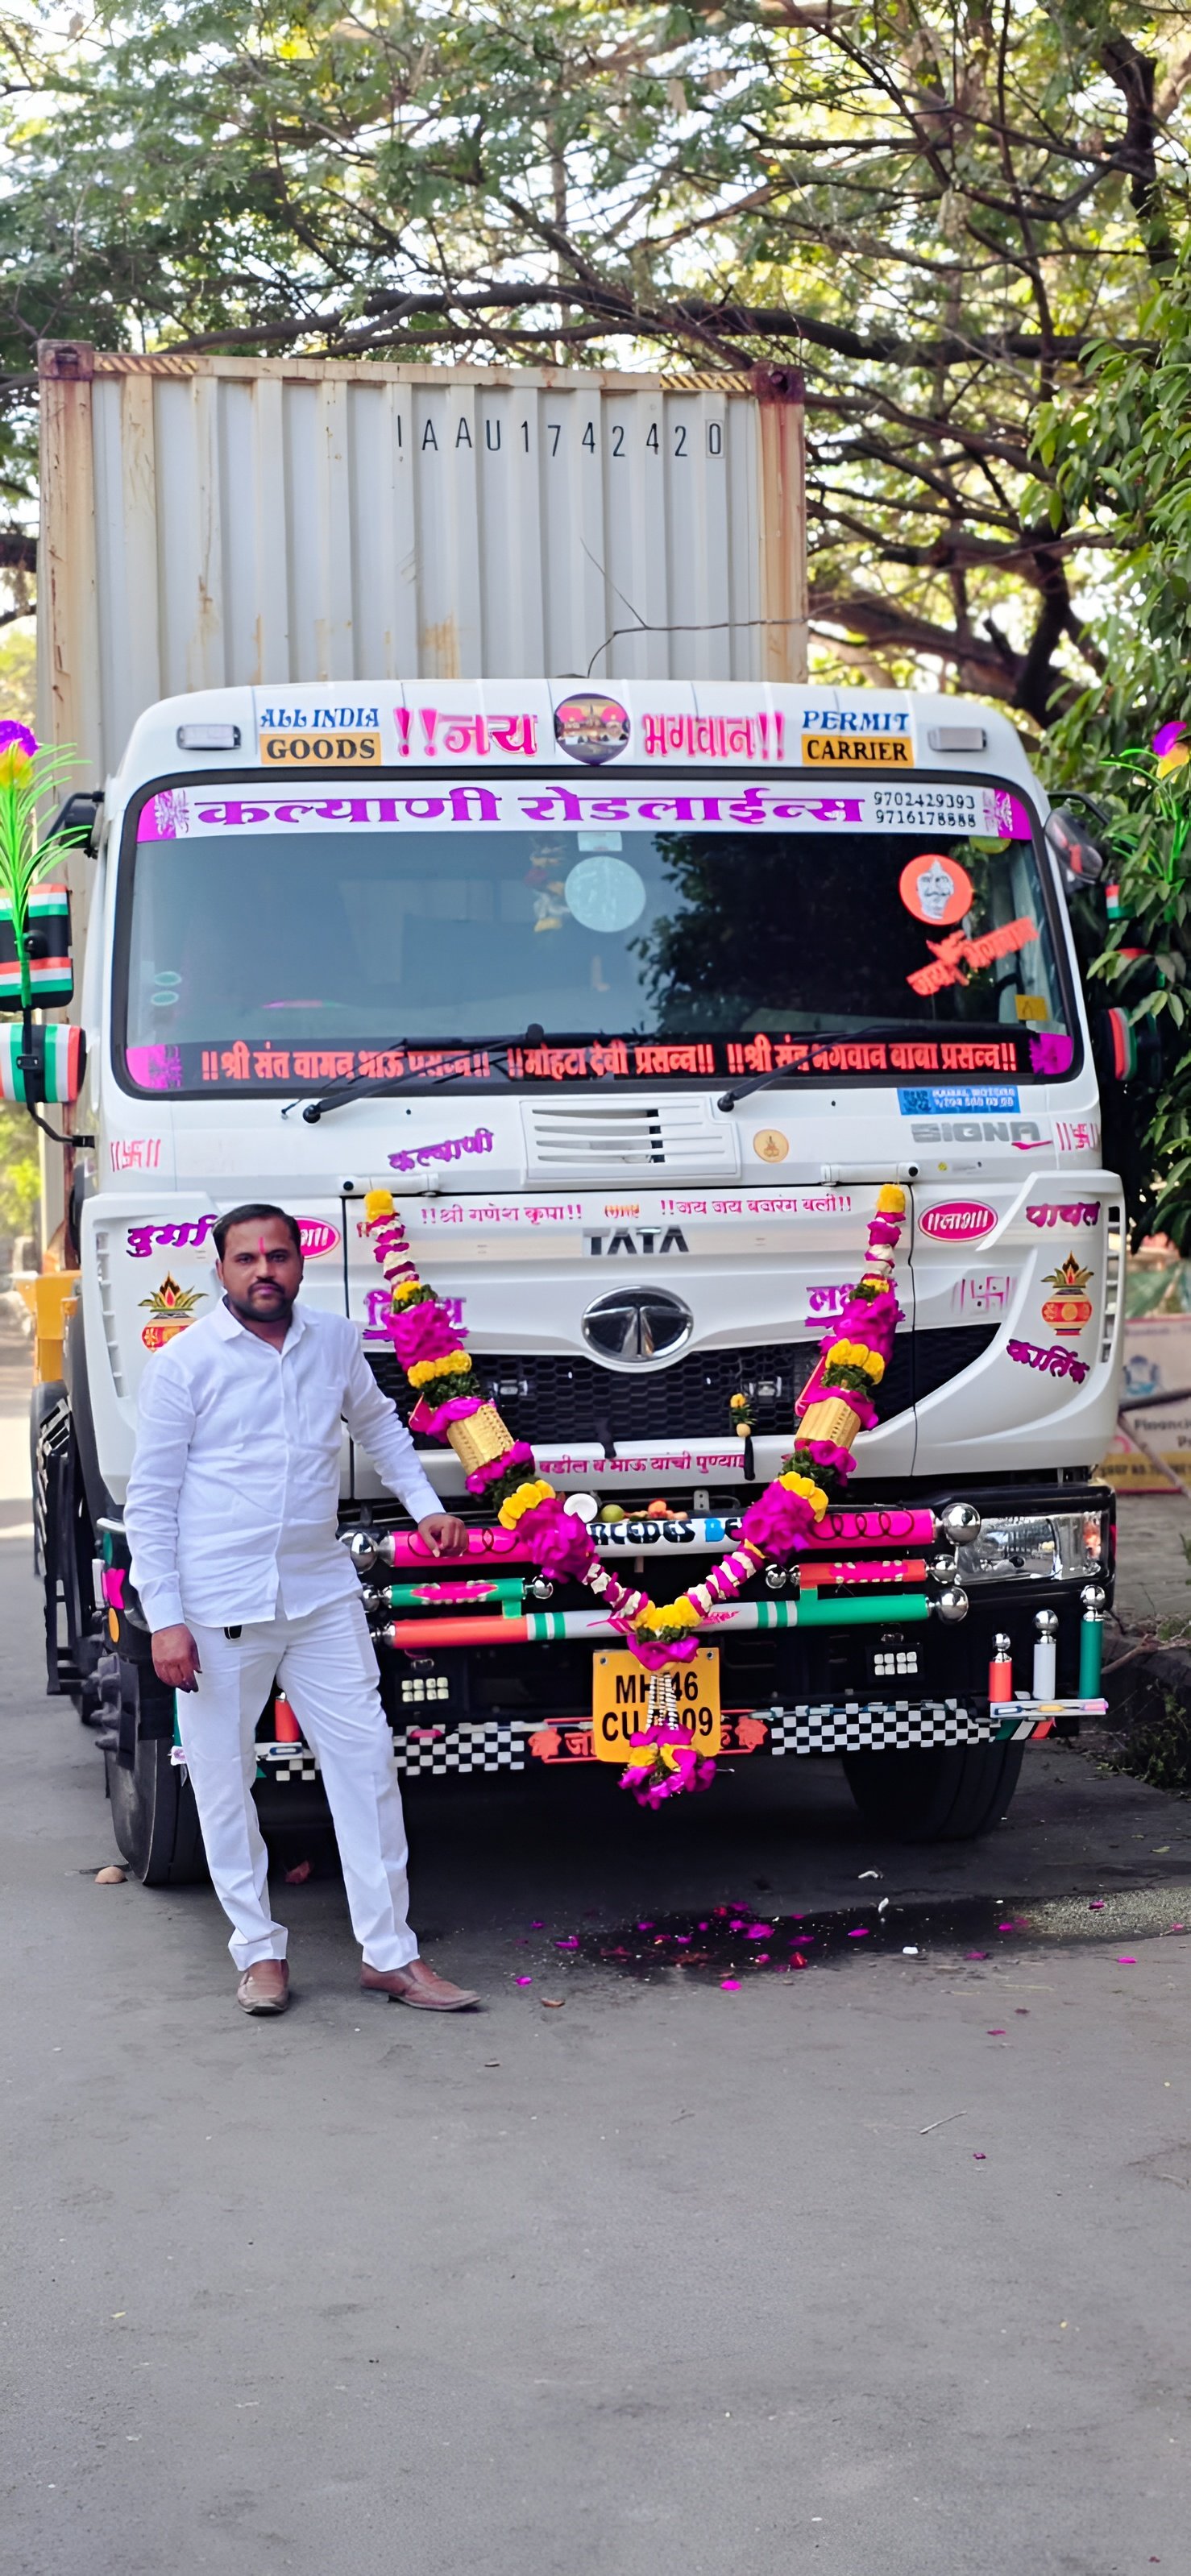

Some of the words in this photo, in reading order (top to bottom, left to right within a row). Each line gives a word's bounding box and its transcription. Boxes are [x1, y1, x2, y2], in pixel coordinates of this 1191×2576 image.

[259, 707, 307, 727] ALL
[311, 707, 379, 727] INDIA
[802, 711, 910, 731] PERMIT
[267, 738, 376, 759] GOODS
[807, 739, 909, 762] CARRIER
[194, 786, 503, 825] कल्याणी
[518, 785, 865, 824] रोडलाईन्स
[874, 791, 976, 810] 9702429393
[875, 810, 977, 828] 9716178888
[253, 1041, 290, 1079] संत
[589, 1038, 629, 1076] देवी
[812, 1042, 887, 1071] भगवान
[889, 1042, 941, 1071] बाबा
[911, 1121, 1040, 1143] SIGNA
[388, 1128, 494, 1172] कल्याणी
[469, 1202, 519, 1223] गणेश
[583, 1226, 690, 1257] TATA
